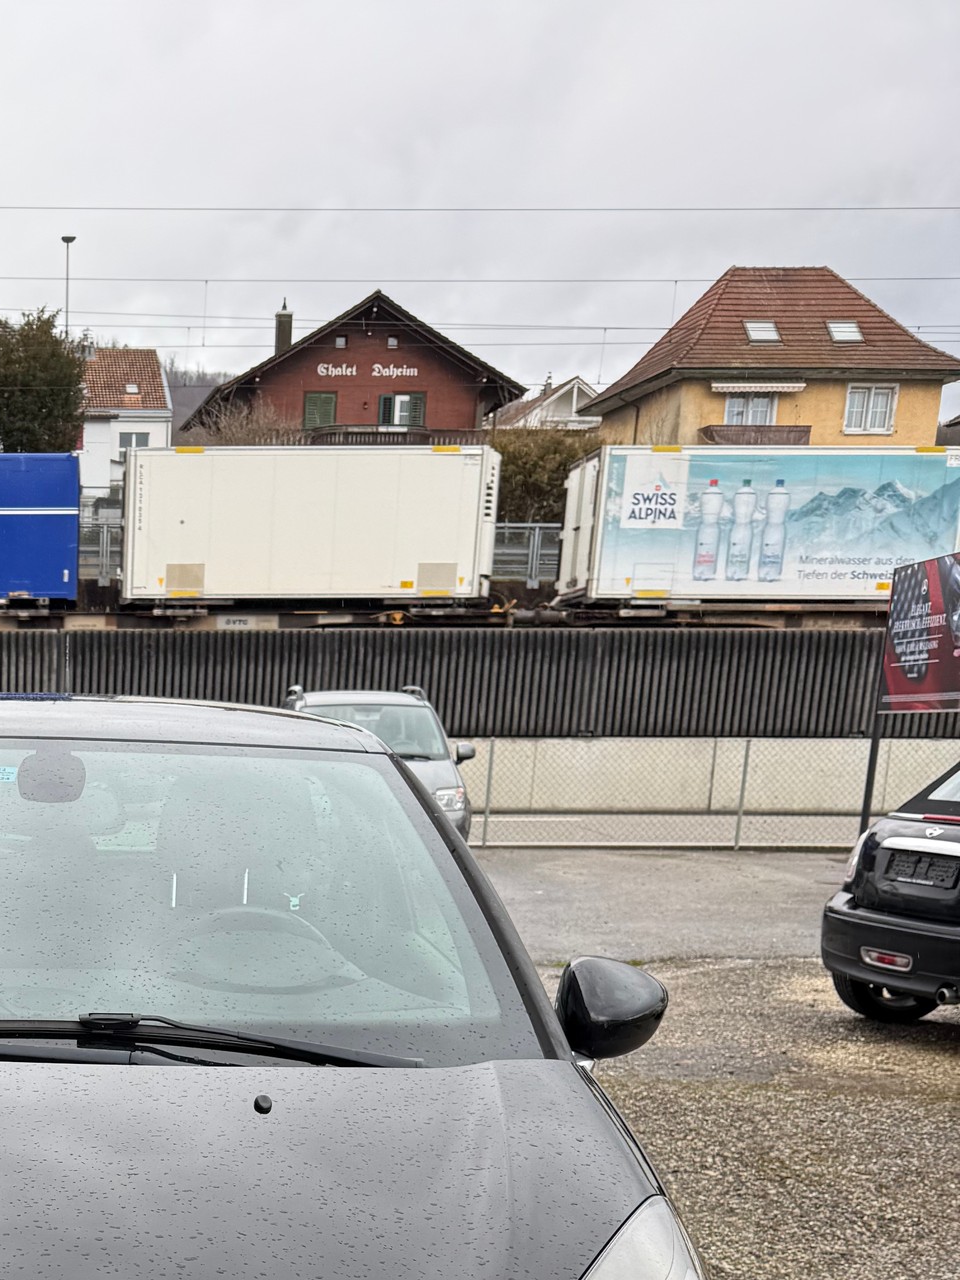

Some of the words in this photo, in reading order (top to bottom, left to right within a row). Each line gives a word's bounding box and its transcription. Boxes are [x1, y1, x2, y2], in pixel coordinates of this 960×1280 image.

[317, 363, 357, 378] Chalet
[371, 363, 418, 379] Daheim
[631, 492, 677, 506] SWISS
[628, 507, 677, 523] ALPINA
[798, 555, 872, 566] Mineralwasser
[874, 557, 893, 566] aus
[797, 569, 829, 580] Tiefen
[830, 570, 848, 580] der
